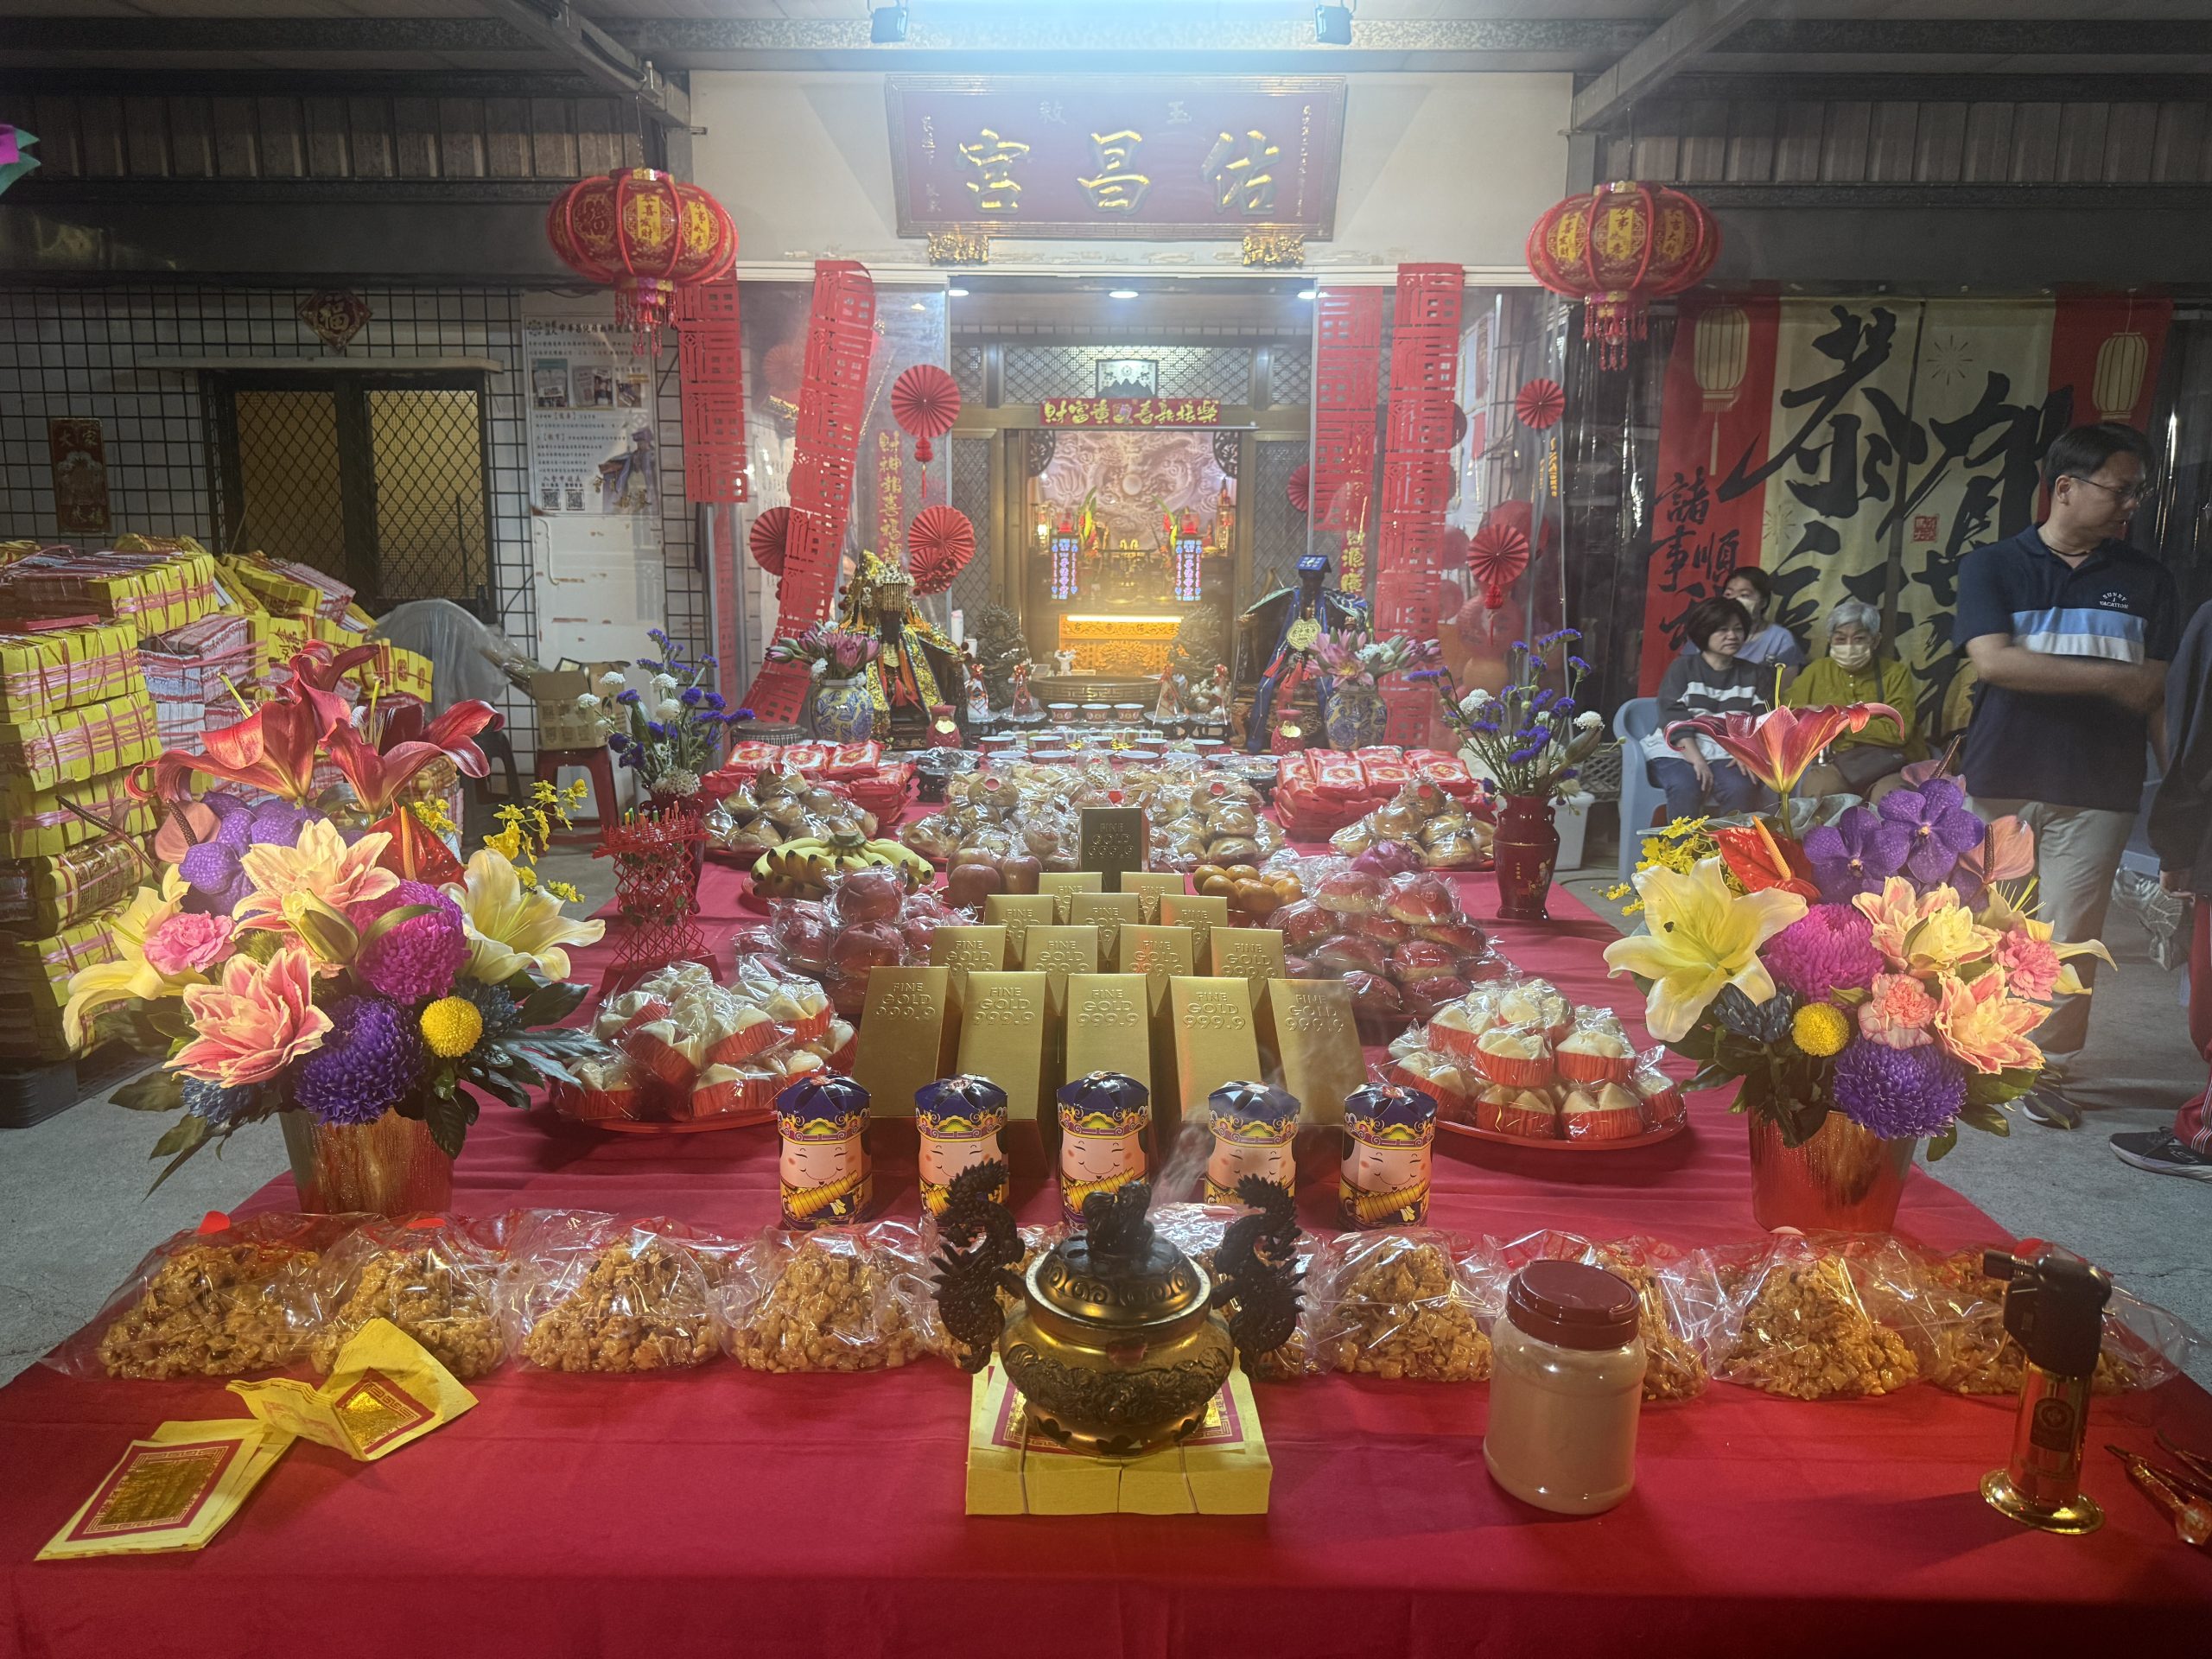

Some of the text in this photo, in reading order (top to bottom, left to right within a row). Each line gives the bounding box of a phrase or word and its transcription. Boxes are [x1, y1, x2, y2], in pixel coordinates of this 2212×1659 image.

[957, 128, 1281, 215] 佑昌宮
[318, 301, 350, 332] 福
[1100, 823, 1124, 832] FINE
[1092, 834, 1131, 844] GOLD
[1141, 886, 1166, 895] FINE
[1006, 909, 1033, 918] FINE
[1092, 907, 1119, 917] FINE
[1181, 909, 1208, 918] FINE
[955, 940, 984, 950] FINE
[1047, 940, 1077, 950] FINE
[1142, 940, 1171, 950] FINE
[1234, 943, 1263, 953] FINE
[946, 951, 991, 962] GOLD
[1038, 951, 1085, 962] GOLD
[1134, 951, 1180, 963] GOLD
[1225, 953, 1272, 965] GOLD
[893, 982, 924, 993] FINE
[989, 987, 1022, 997] FINE
[1091, 988, 1123, 1000] FINE
[1196, 992, 1228, 1002] FINE
[1296, 993, 1327, 1004] FINE
[881, 994, 931, 1006] GOLD
[978, 999, 1031, 1010] GOLD
[1082, 1001, 1135, 1013] GOLD
[1186, 1002, 1239, 1015] GOLD
[1288, 1005, 1338, 1018] GOLD
[874, 1007, 937, 1020] 999.9
[973, 1011, 1035, 1026] 999.9
[1076, 1013, 1140, 1027] 999.9
[1182, 1014, 1246, 1030] 999.9
[1285, 1018, 1344, 1033] 999.9
